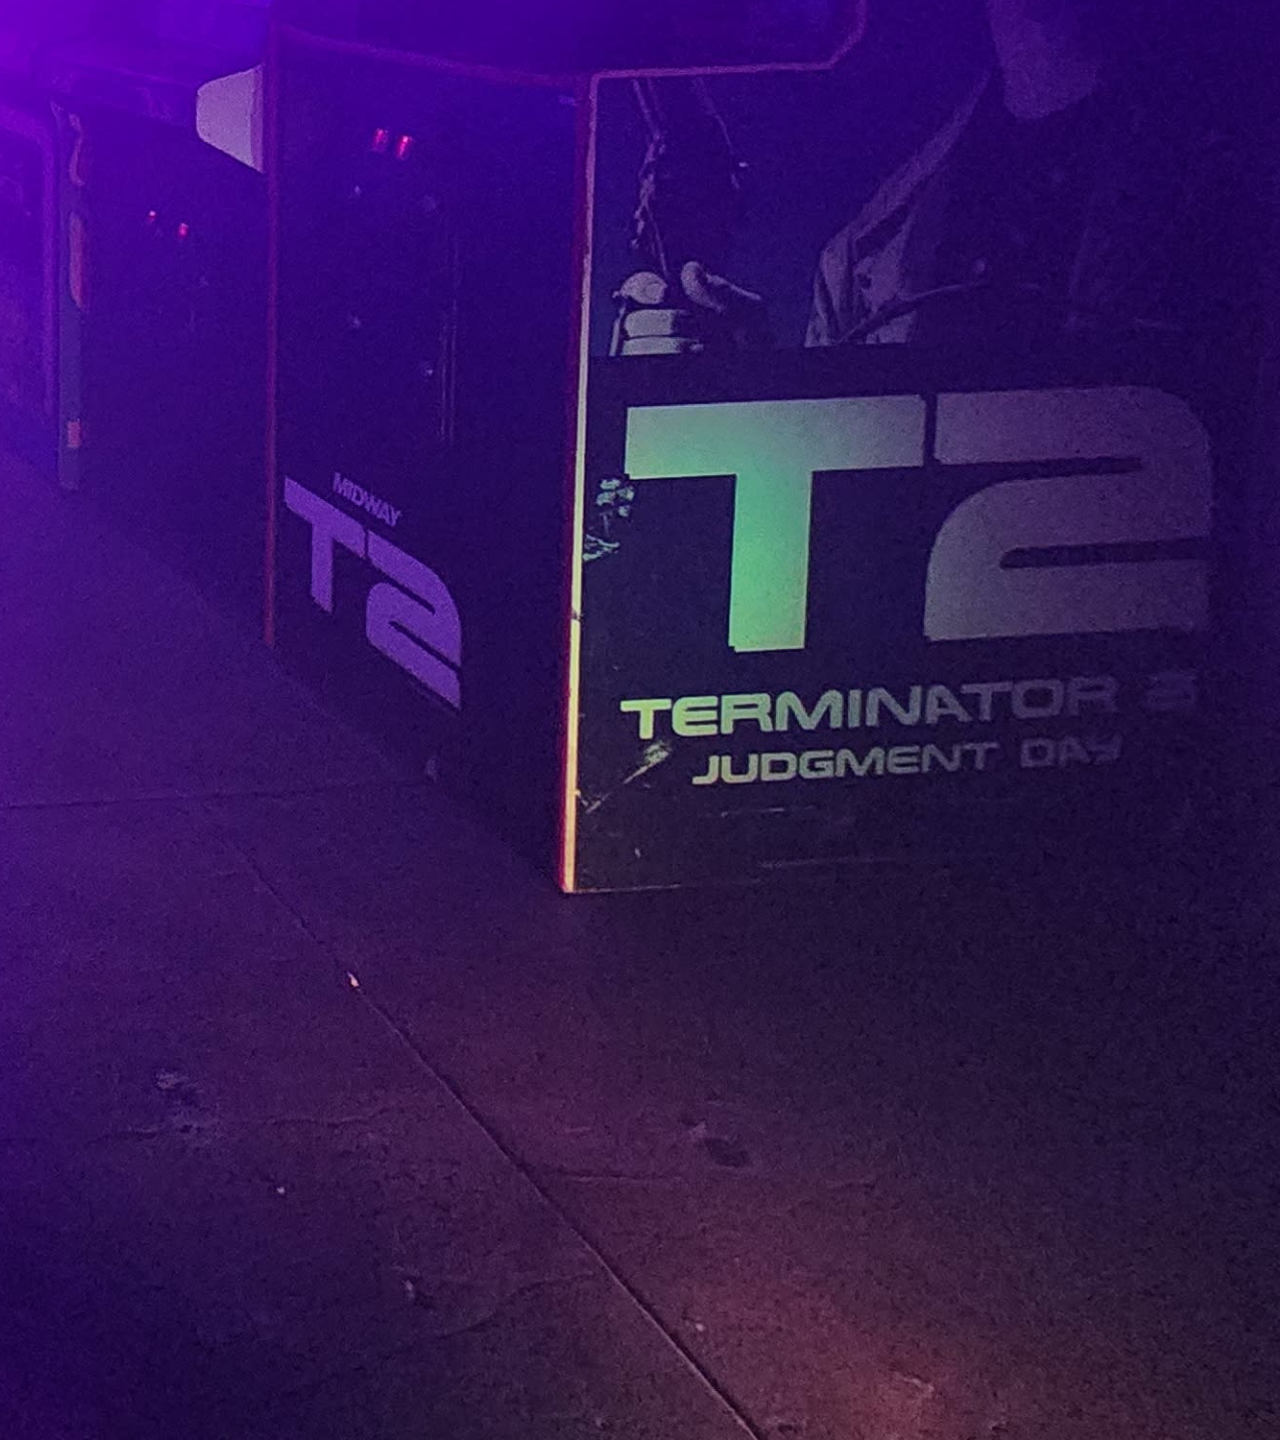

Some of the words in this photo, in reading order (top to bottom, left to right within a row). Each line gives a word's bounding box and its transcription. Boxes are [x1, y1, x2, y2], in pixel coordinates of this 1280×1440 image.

[332, 471, 403, 528] MIDWAY
[624, 384, 1212, 653] T2
[284, 475, 462, 711] T2
[620, 673, 1120, 741] TERMINATOR
[691, 740, 1001, 786] JUDGMENT
[1019, 732, 1124, 769] DAY
